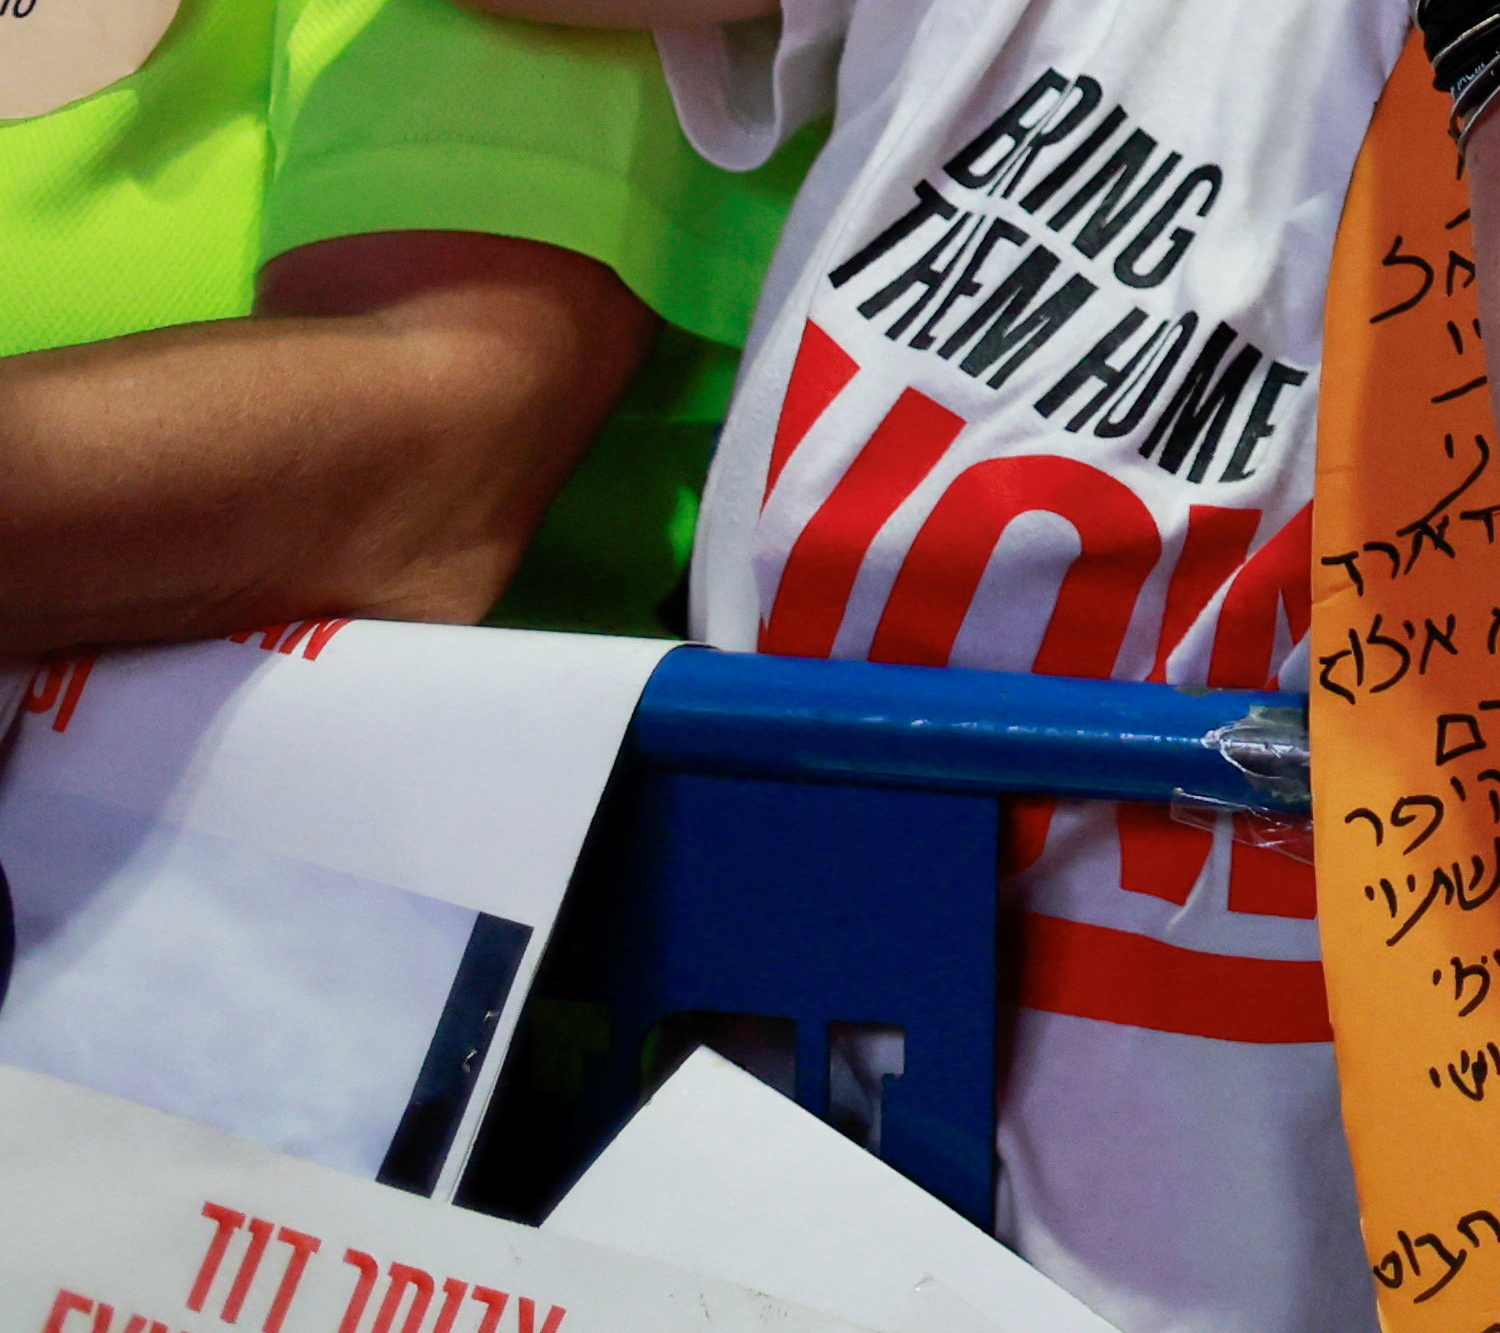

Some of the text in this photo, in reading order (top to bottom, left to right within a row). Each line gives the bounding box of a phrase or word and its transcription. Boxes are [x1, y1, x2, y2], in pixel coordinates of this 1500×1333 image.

[942, 67, 1223, 290] BRING
[1032, 306, 1308, 485] HOME
[185, 1200, 322, 1333] דוד
